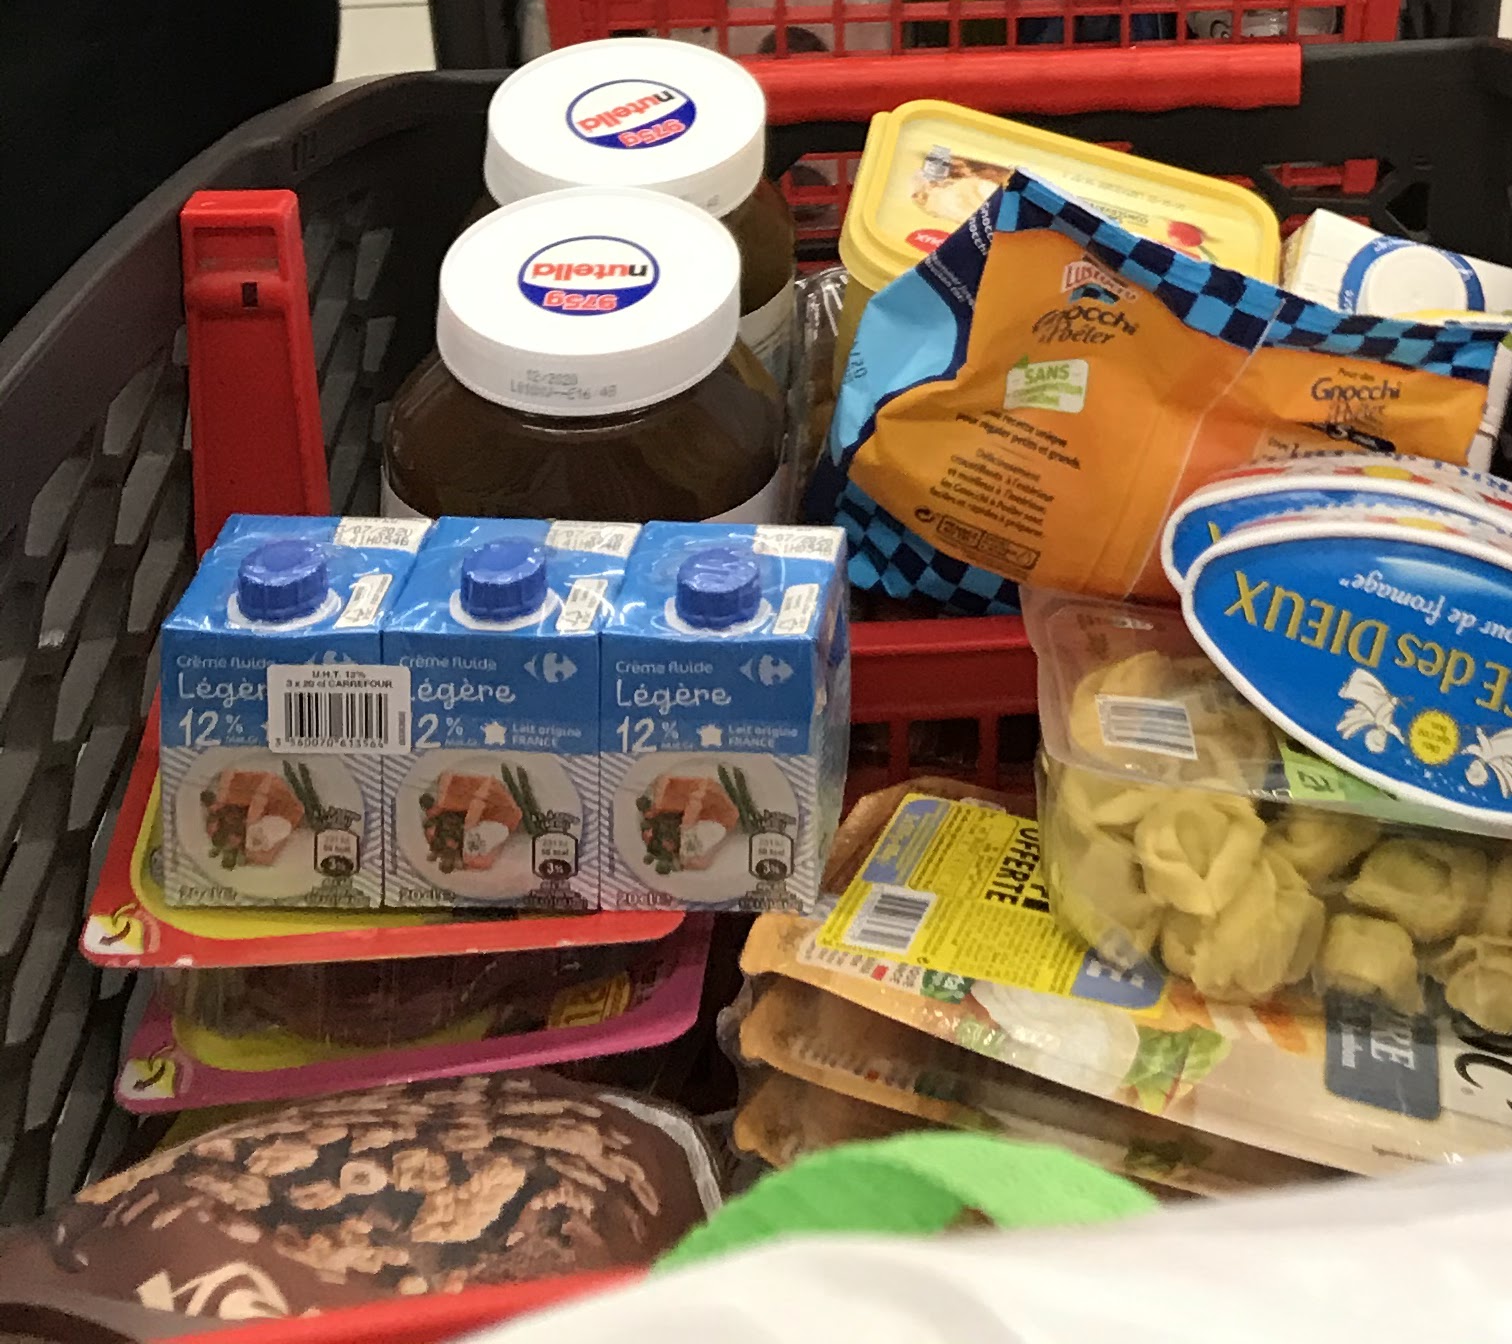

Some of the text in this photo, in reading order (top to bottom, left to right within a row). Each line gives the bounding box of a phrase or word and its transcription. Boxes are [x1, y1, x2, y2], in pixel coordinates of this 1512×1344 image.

[576, 90, 676, 133] nutella
[618, 118, 686, 147] 975g
[532, 262, 648, 281] nutella
[543, 290, 619, 310] 975g
[1024, 364, 1071, 385] SANS
[1310, 376, 1403, 402] Gnocchi
[1223, 569, 1391, 670] DIEUX
[1449, 603, 1478, 637] de
[176, 654, 229, 670] Crème
[400, 655, 498, 671] Crème fluide
[615, 660, 714, 675] Crème fluide
[1394, 632, 1478, 695] des
[178, 671, 268, 708] Légèr
[327, 679, 394, 689] CARREFOUR
[411, 677, 516, 710] égère
[616, 678, 732, 715] Légère
[512, 723, 582, 739] Lait origine
[728, 725, 799, 739] Lait origine
[512, 735, 559, 748] FRANCE
[728, 736, 776, 749] FRANCE
